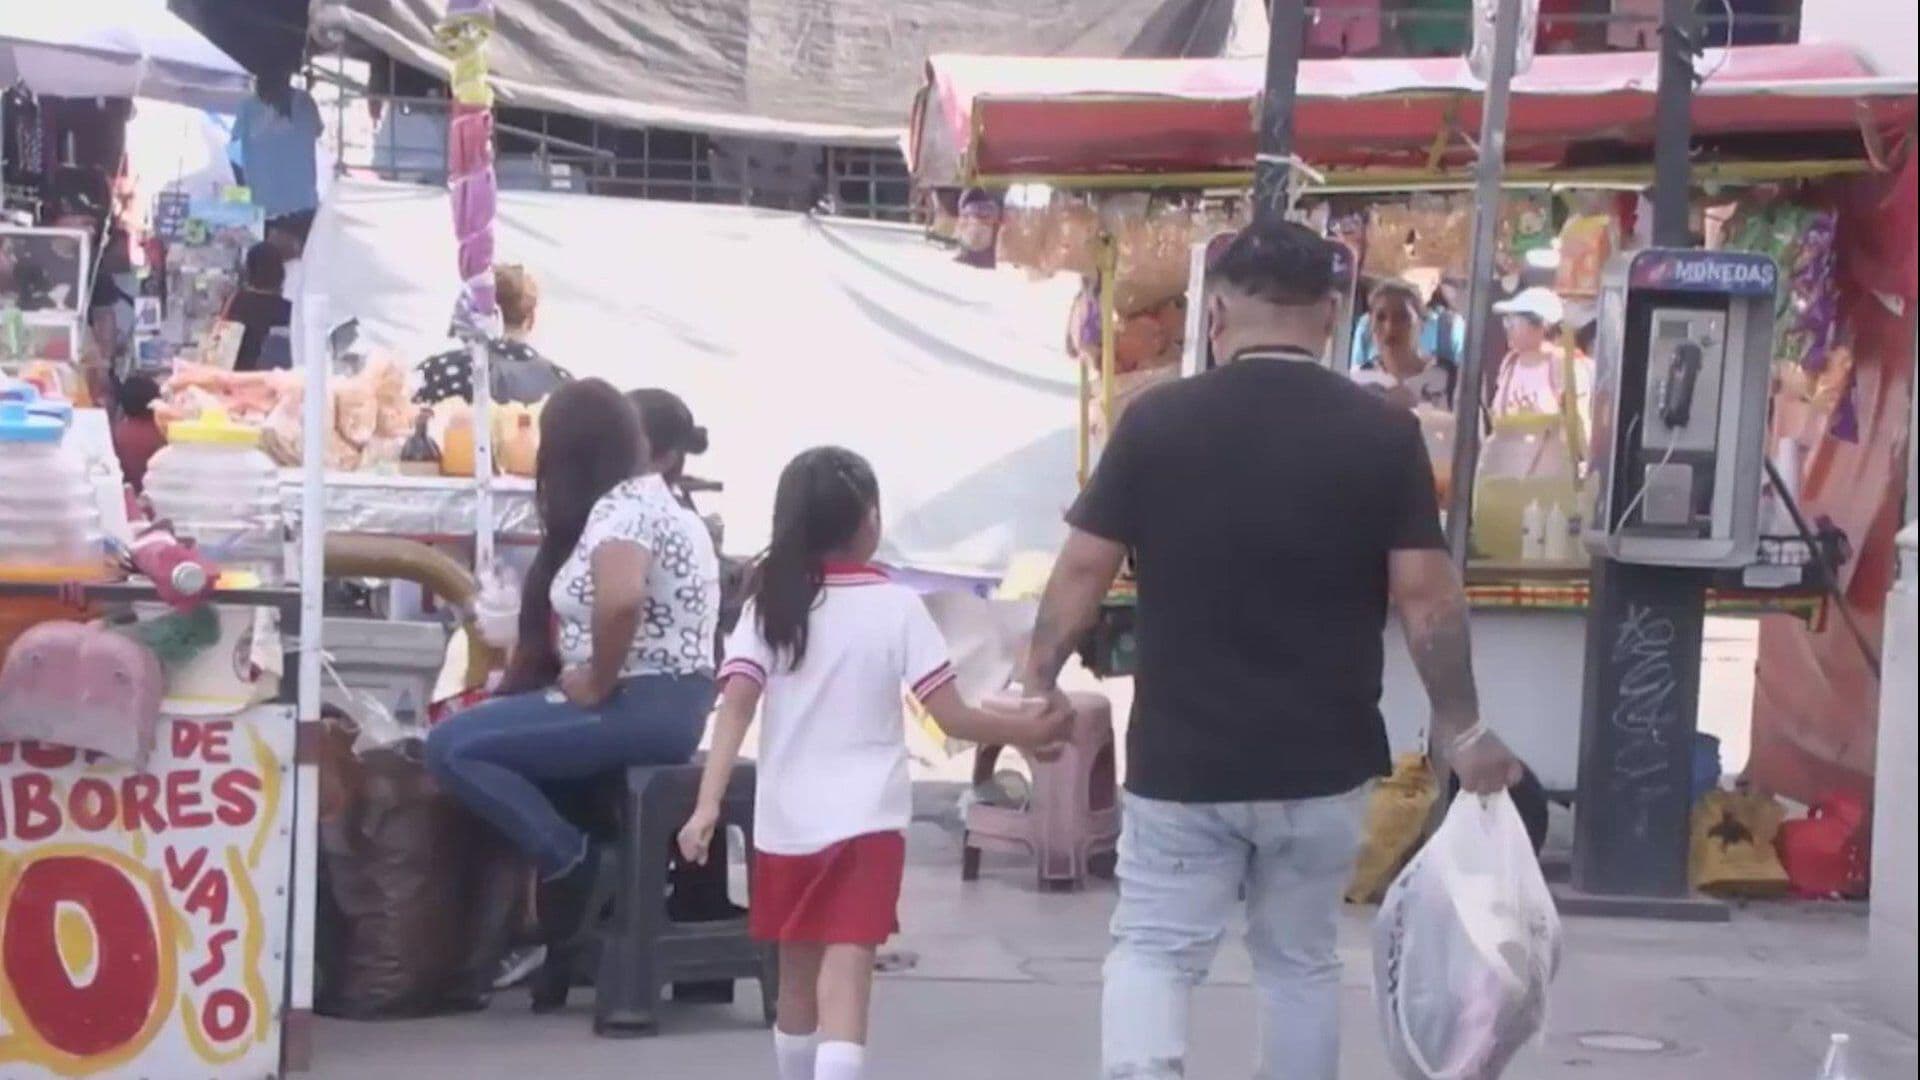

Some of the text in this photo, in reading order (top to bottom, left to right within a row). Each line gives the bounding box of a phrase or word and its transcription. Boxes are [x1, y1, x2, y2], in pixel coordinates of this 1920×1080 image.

[1675, 257, 1775, 286] MONEDAS
[172, 719, 234, 764] DE
[0, 769, 262, 841] BORES
